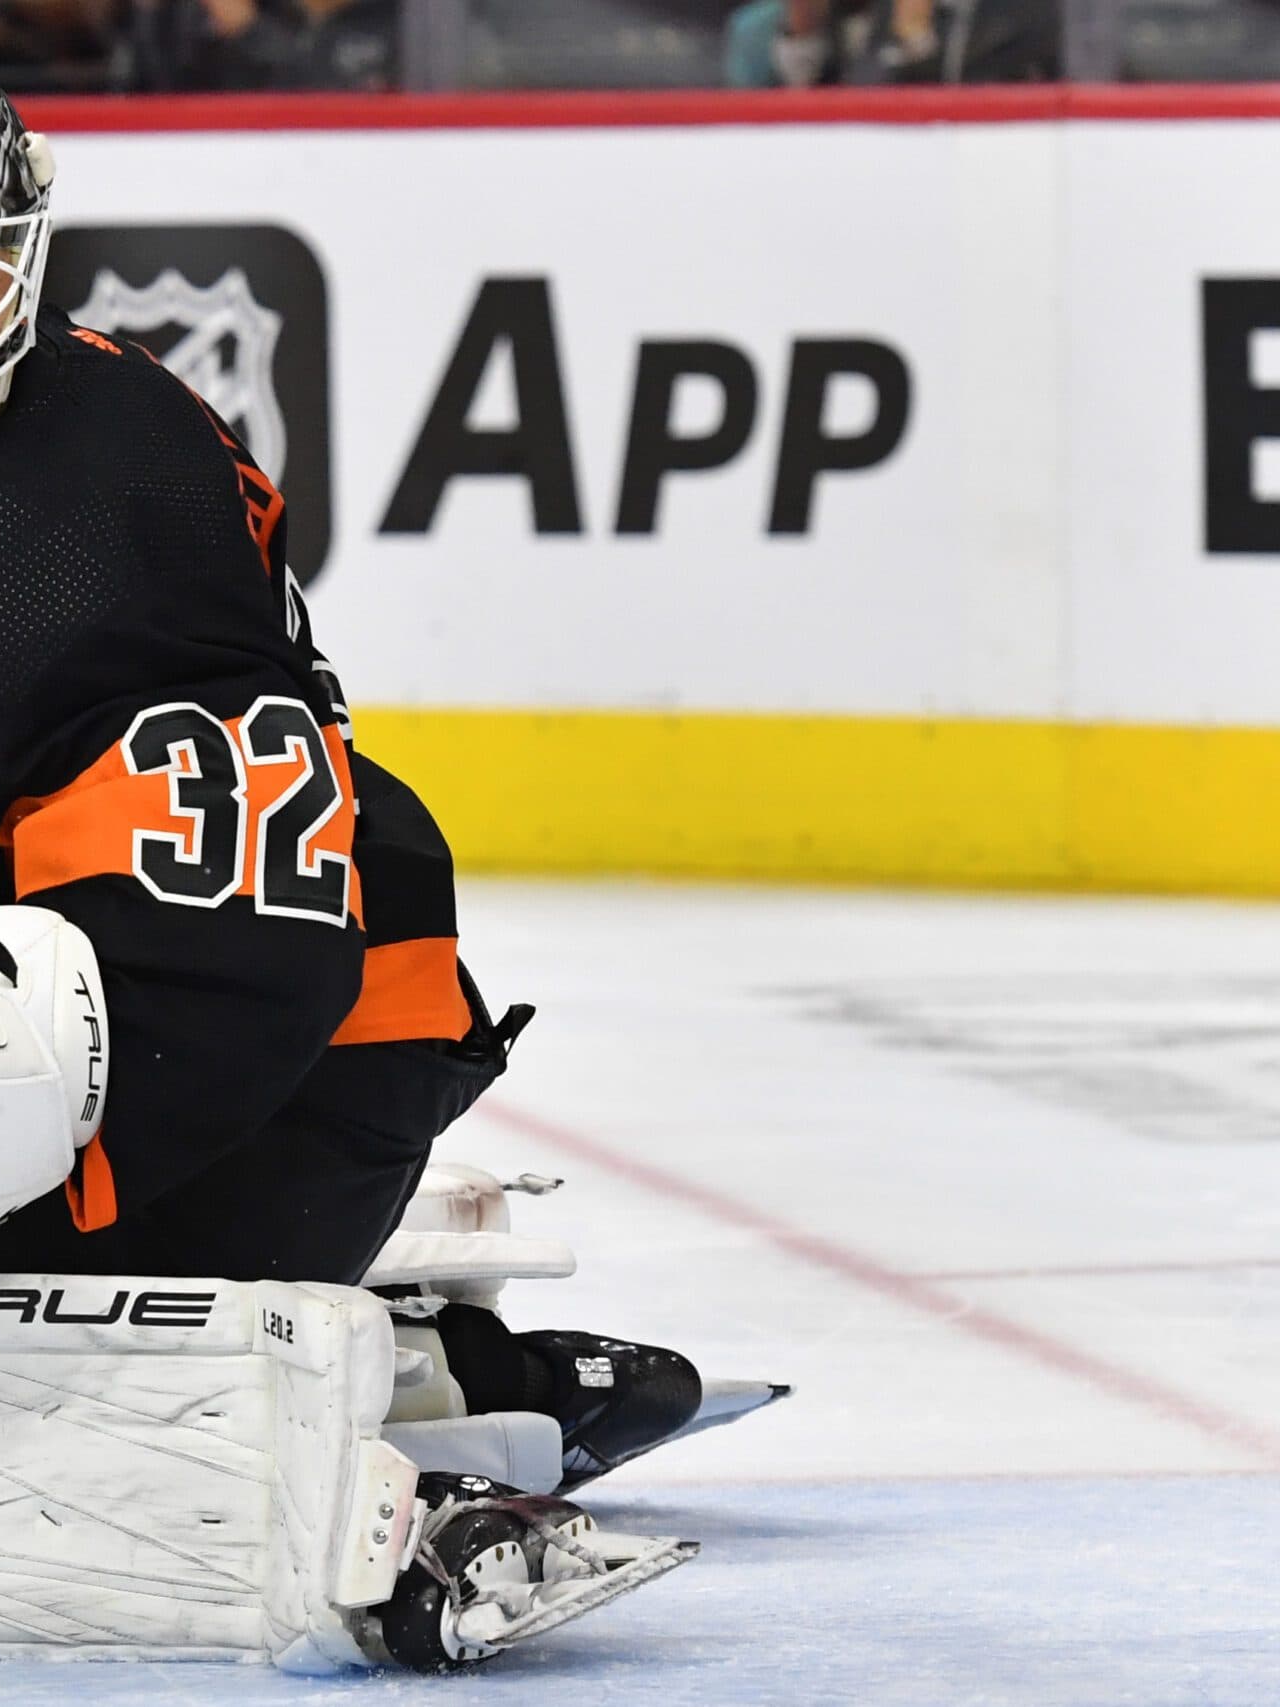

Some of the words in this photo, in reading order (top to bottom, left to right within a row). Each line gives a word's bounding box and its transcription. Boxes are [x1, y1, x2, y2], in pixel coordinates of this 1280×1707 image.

[120, 696, 350, 929] 32
[74, 970, 103, 1122] TRUE
[262, 1308, 294, 1345] L20.2
